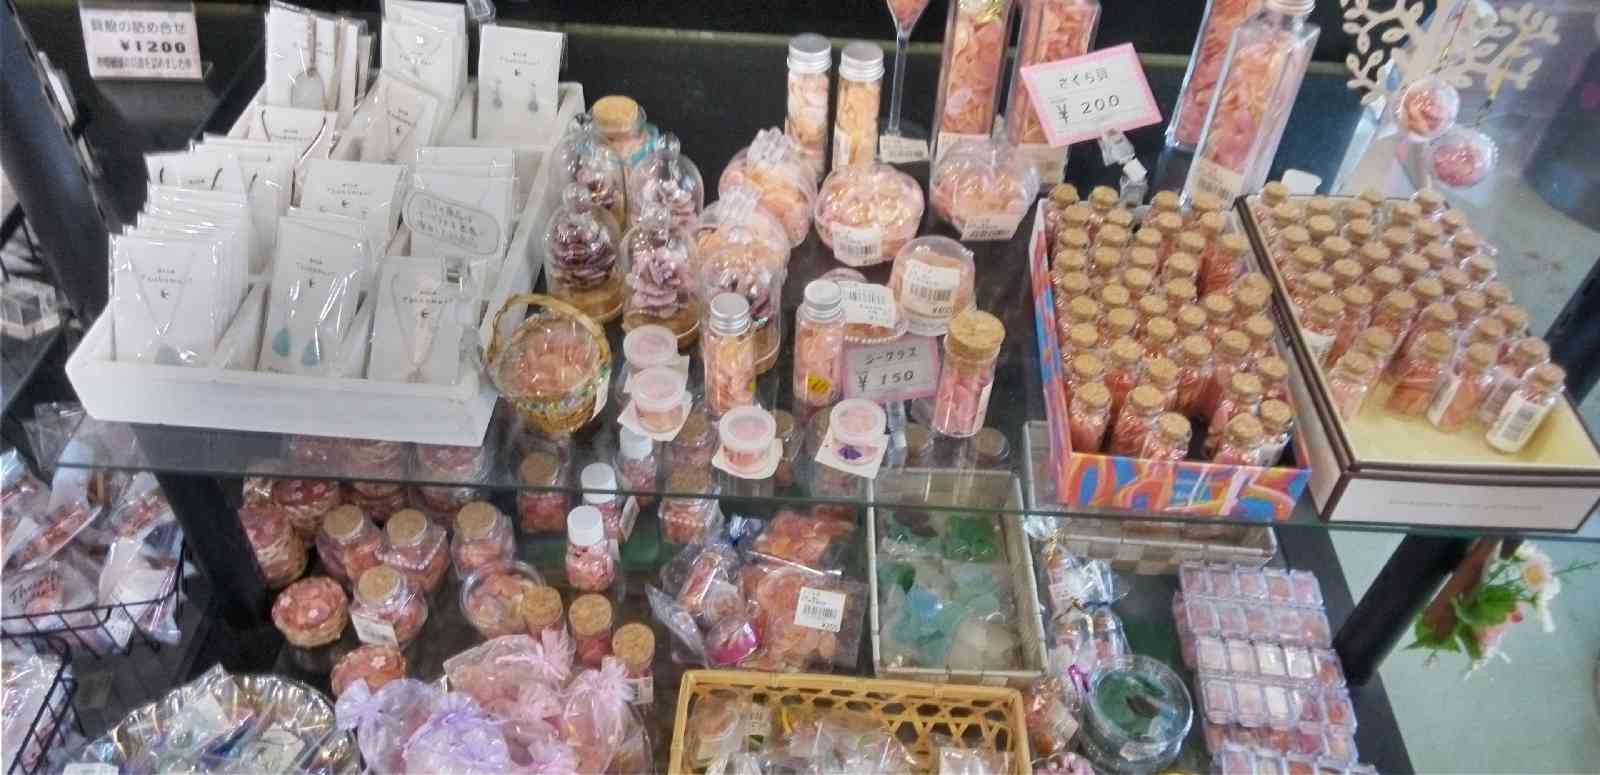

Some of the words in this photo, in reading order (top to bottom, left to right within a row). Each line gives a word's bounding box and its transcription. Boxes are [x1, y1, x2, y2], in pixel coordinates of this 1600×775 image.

[120, 40, 186, 53] ¥1200
[1059, 67, 1108, 88] さくら貝
[1081, 95, 1119, 114] 200
[881, 370, 914, 385] 150
